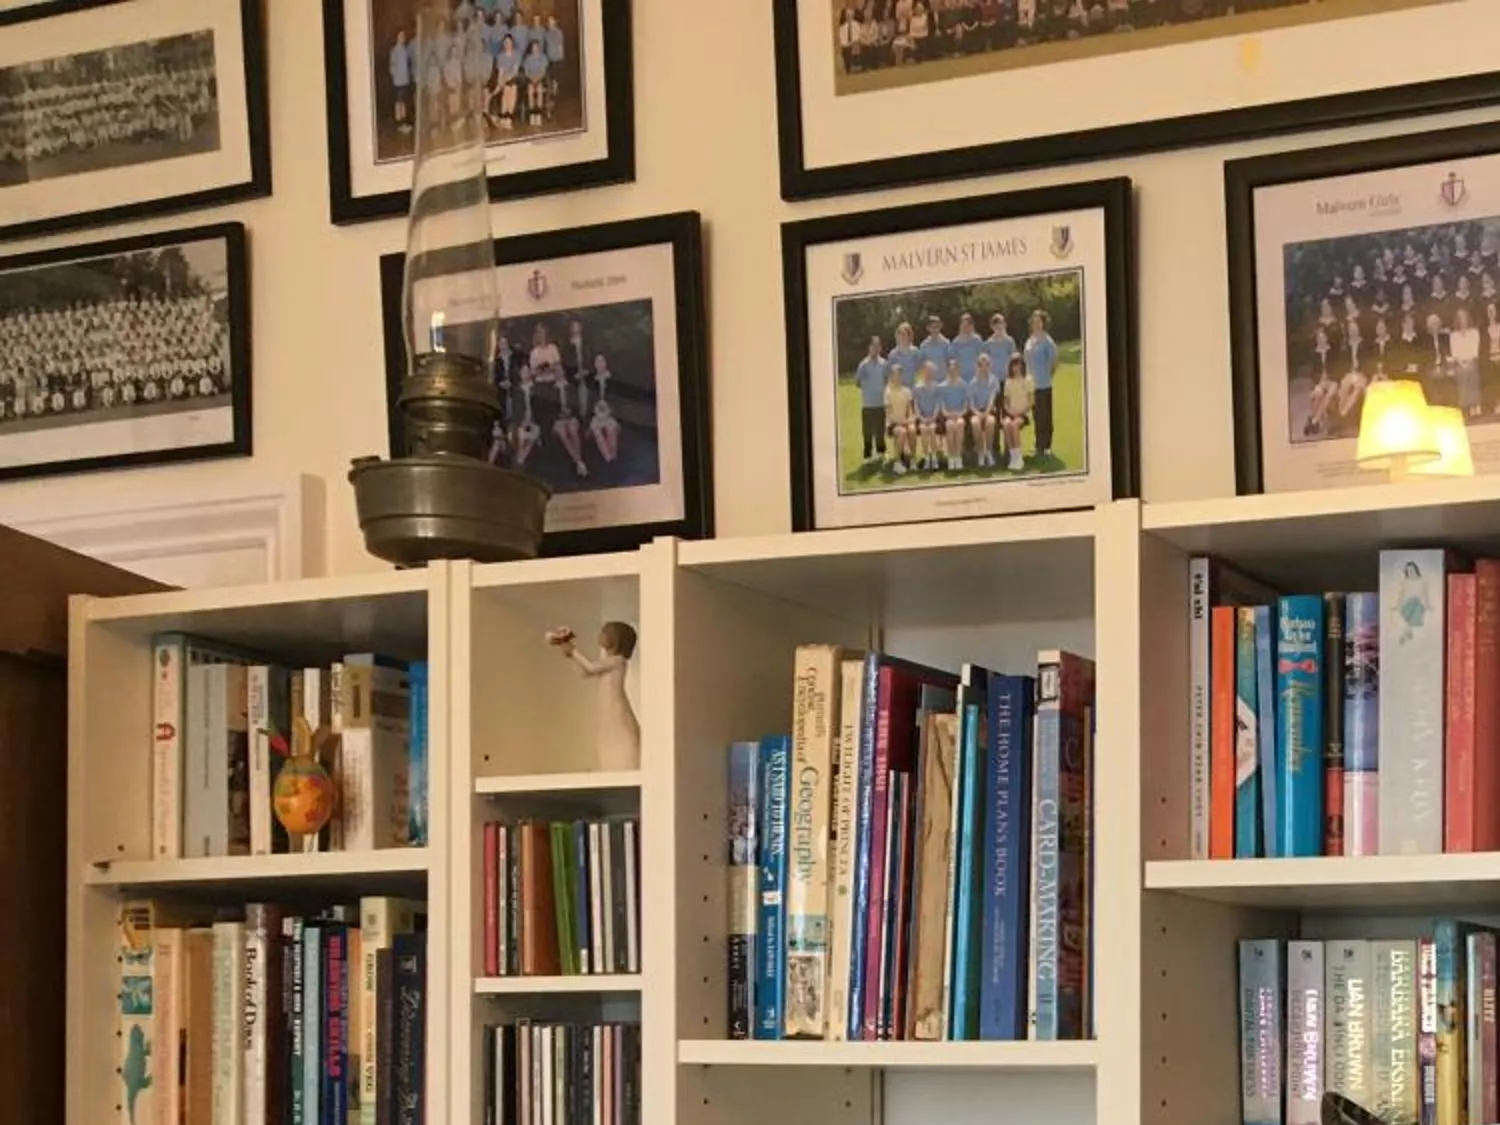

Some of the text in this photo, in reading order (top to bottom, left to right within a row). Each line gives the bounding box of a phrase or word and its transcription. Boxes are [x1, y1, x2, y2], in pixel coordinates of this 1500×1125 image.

[882, 237, 1028, 272] MALVERN ST JAMES
[840, 724, 855, 815] TWILIGHT OF
[993, 693, 1013, 898] THE HOME PLANS BOOK
[792, 767, 821, 883] Geography
[1035, 799, 1057, 982] CARD-MAKING
[243, 946, 258, 1009] Book of
[1332, 964, 1346, 1016] THE DA
[1388, 948, 1410, 1041] BARBARA
[1303, 988, 1318, 1101] DAN BROWN
[1347, 978, 1364, 1090] DAN BROWN
